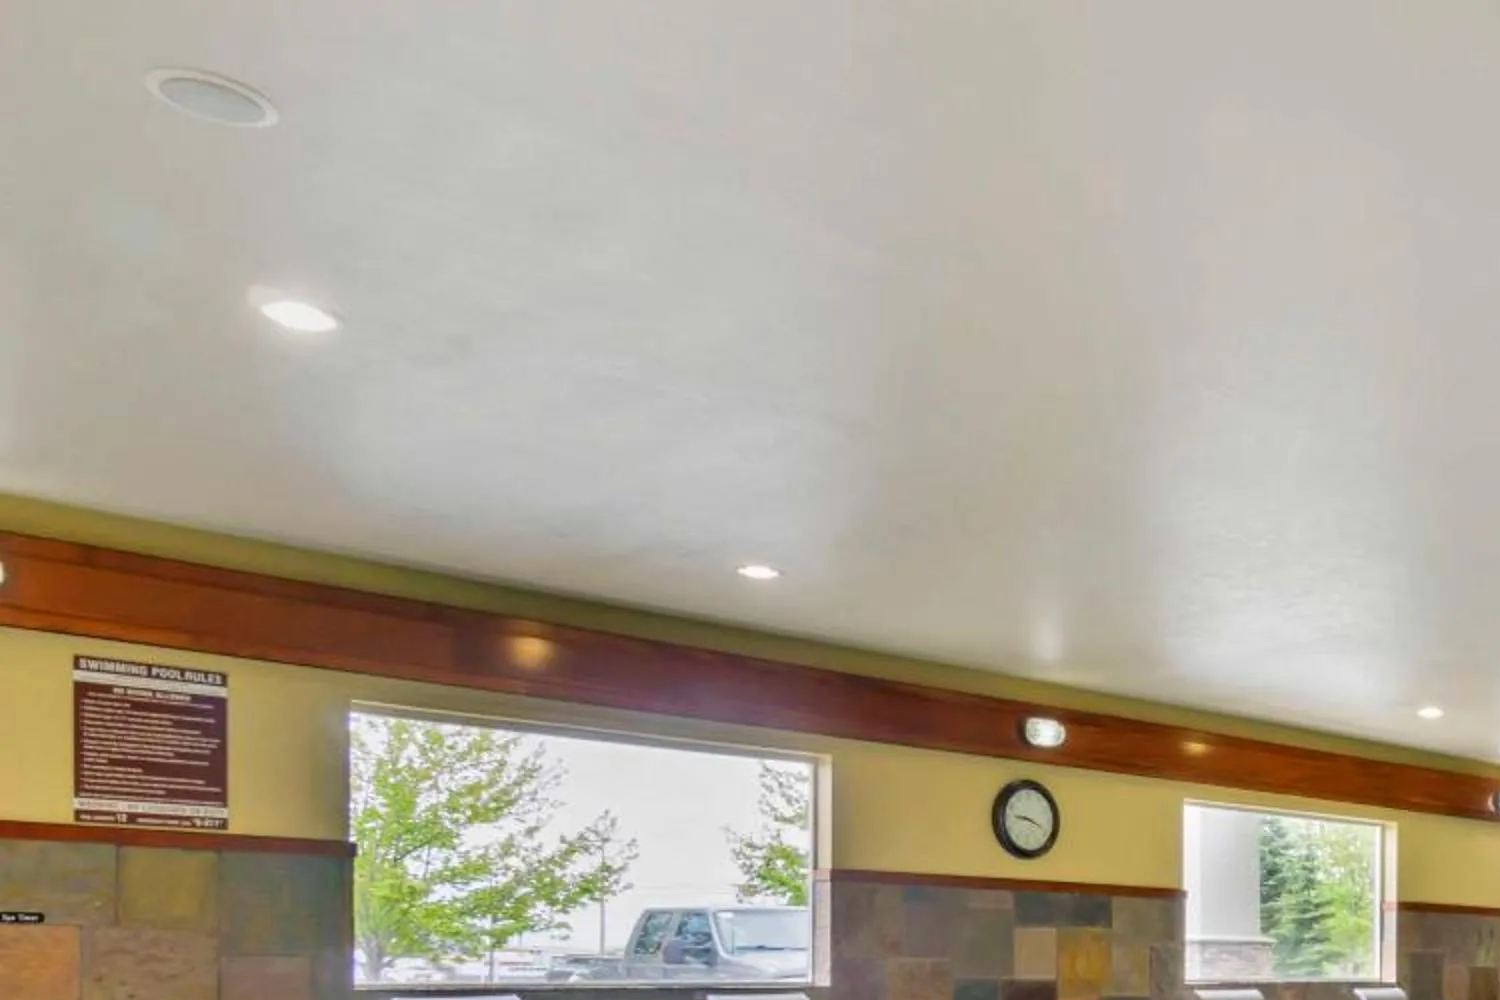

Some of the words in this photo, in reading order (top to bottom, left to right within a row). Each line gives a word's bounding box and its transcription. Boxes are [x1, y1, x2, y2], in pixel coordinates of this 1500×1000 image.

[79, 657, 148, 676] SWIMMING
[151, 666, 184, 680] POOL
[184, 671, 223, 684] RULES
